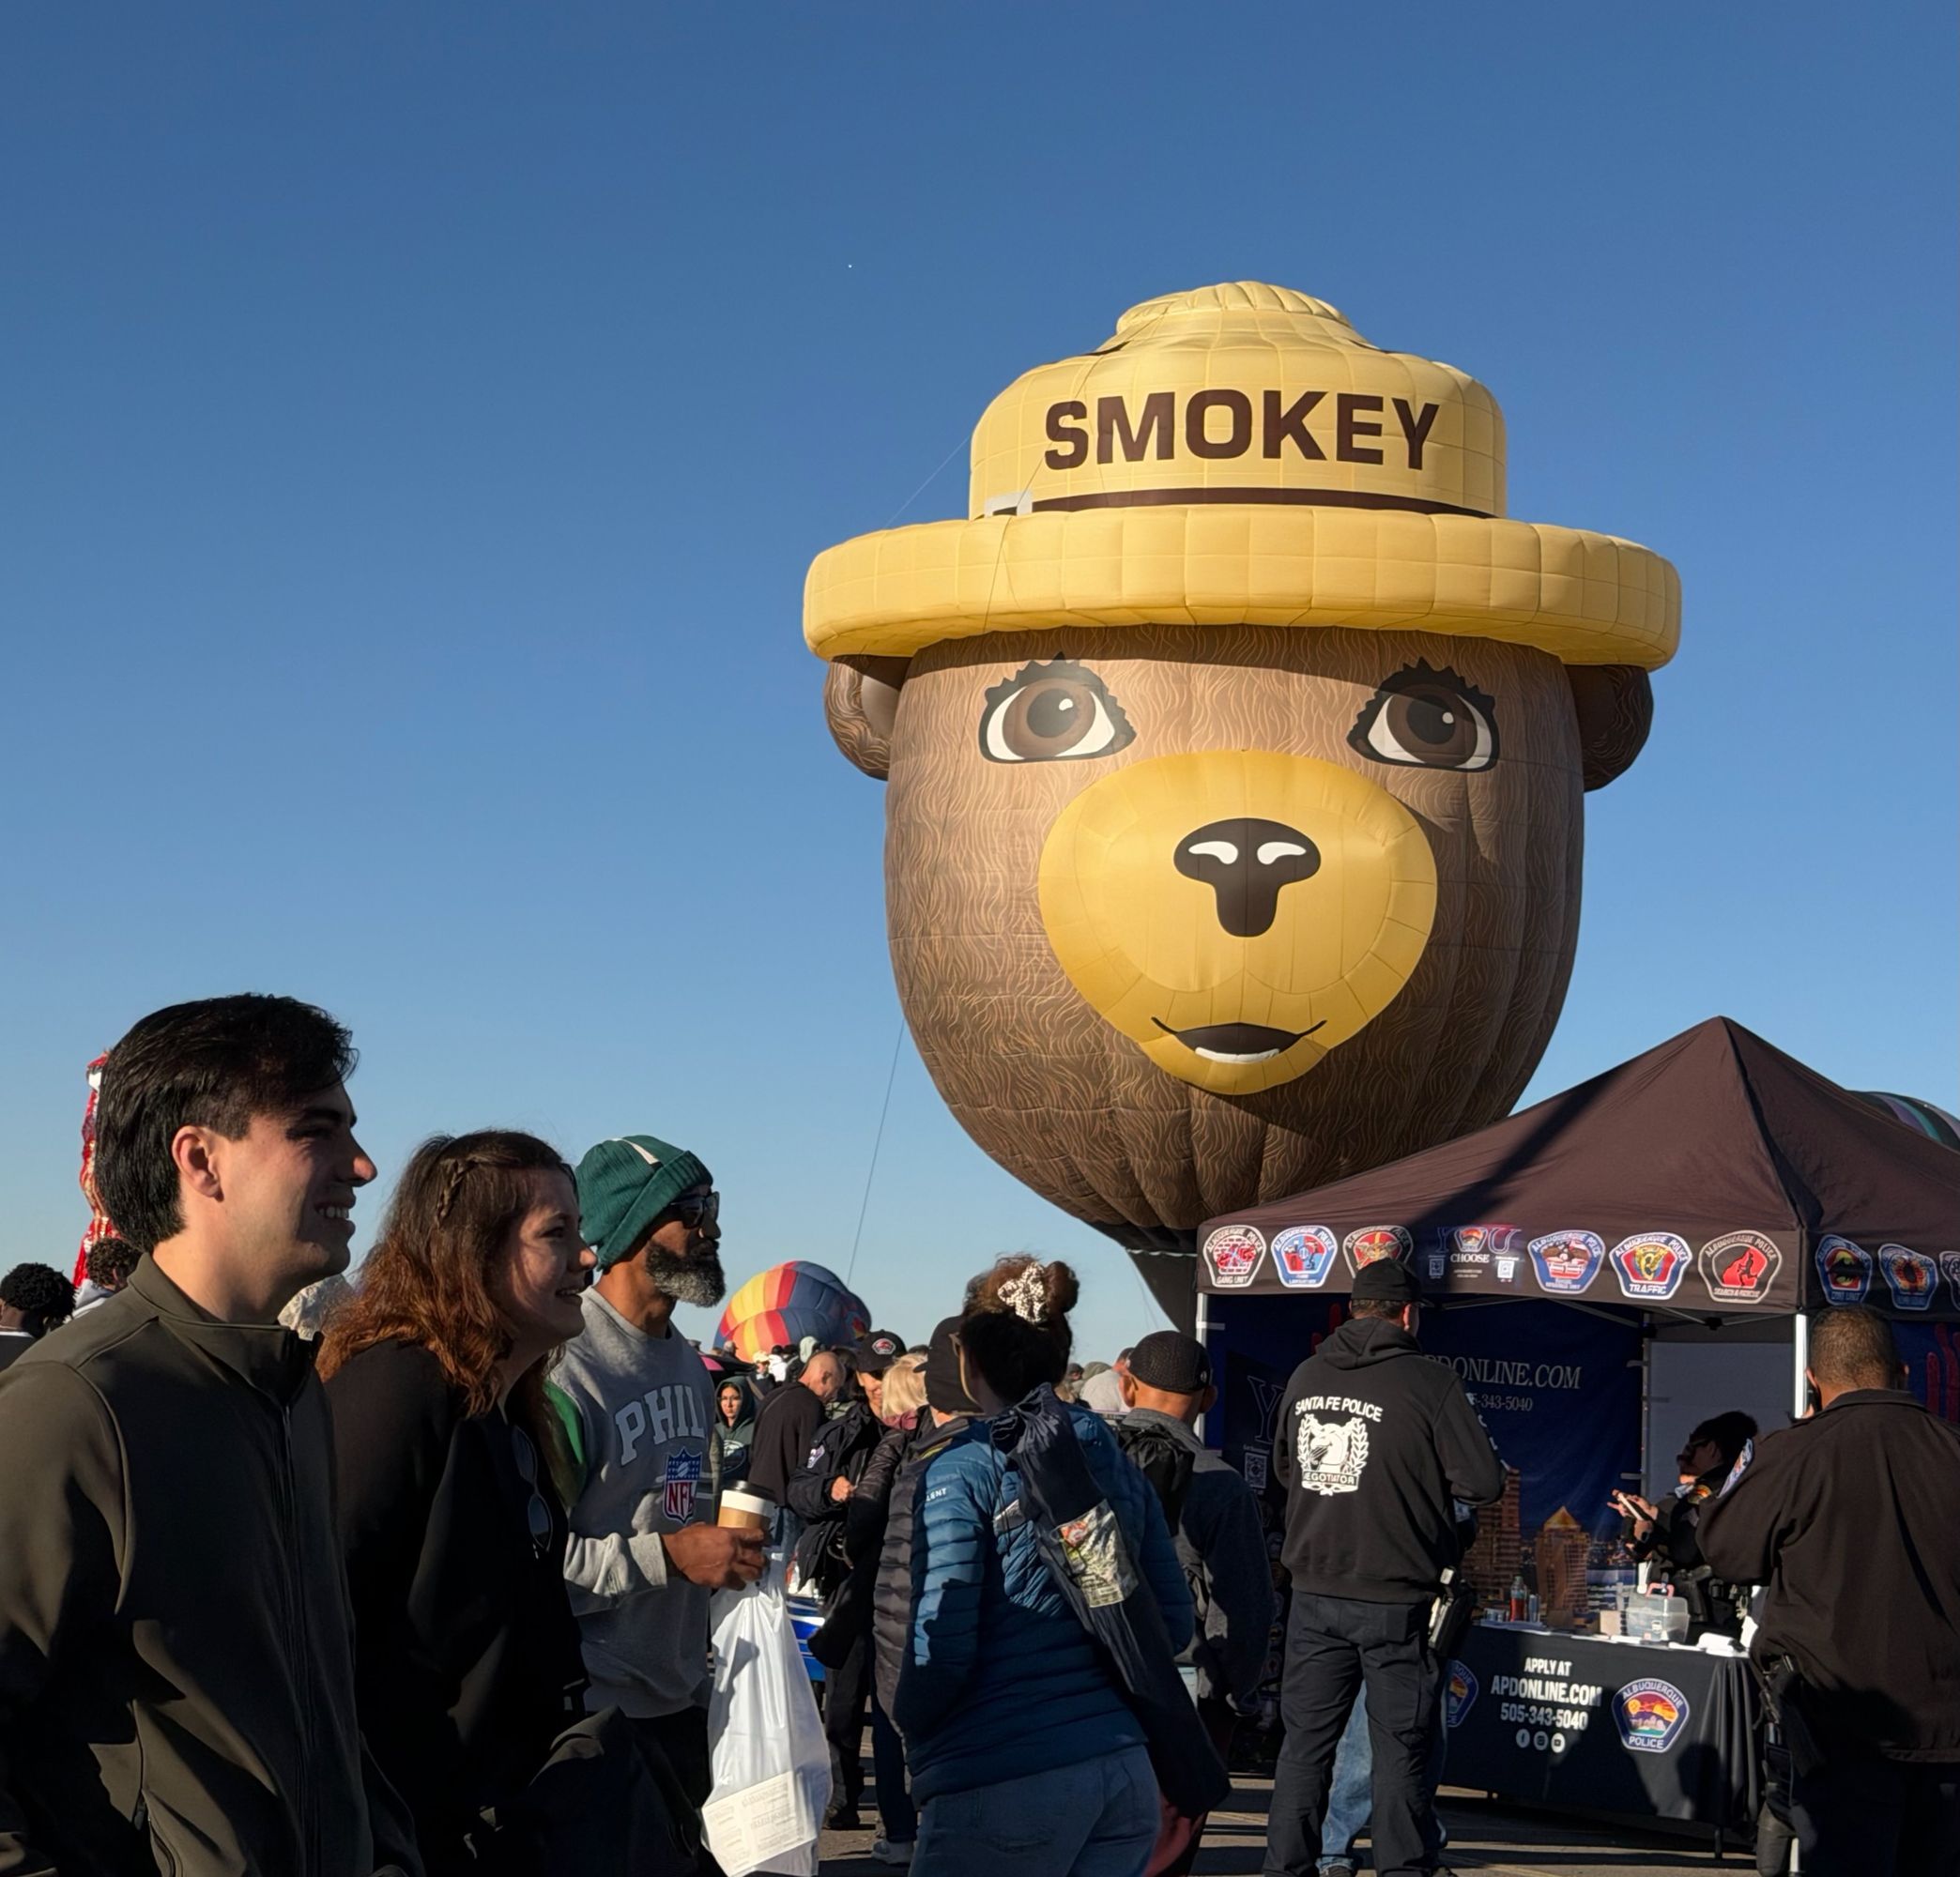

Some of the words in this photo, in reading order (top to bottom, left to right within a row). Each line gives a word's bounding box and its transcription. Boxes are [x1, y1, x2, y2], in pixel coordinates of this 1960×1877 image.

[1044, 389, 1440, 471] SMOKEY
[1450, 1254, 1490, 1263] CHOOSE
[1585, 1233, 1601, 1258] POLICE
[1615, 1236, 1668, 1258] ALBUQUERQUE
[1667, 1239, 1689, 1263] POLICE
[1705, 1235, 1754, 1258] ALBUQUERQUE
[1753, 1238, 1777, 1260] POLICE
[1629, 1283, 1668, 1295] TRAFFIC
[1294, 1396, 1325, 1415] SANTA
[1325, 1396, 1342, 1412] FE
[1340, 1397, 1384, 1423] POLICE
[667, 1481, 695, 1516] NFL
[1524, 1656, 1557, 1675] APPLY
[1556, 1660, 1572, 1677] AT
[1491, 1674, 1603, 1707] APDONLINE.COM
[1622, 1681, 1683, 1709] ALBUQUERQUE
[1500, 1702, 1588, 1731] 505-343-5040
[1628, 1735, 1664, 1749] POLICE
